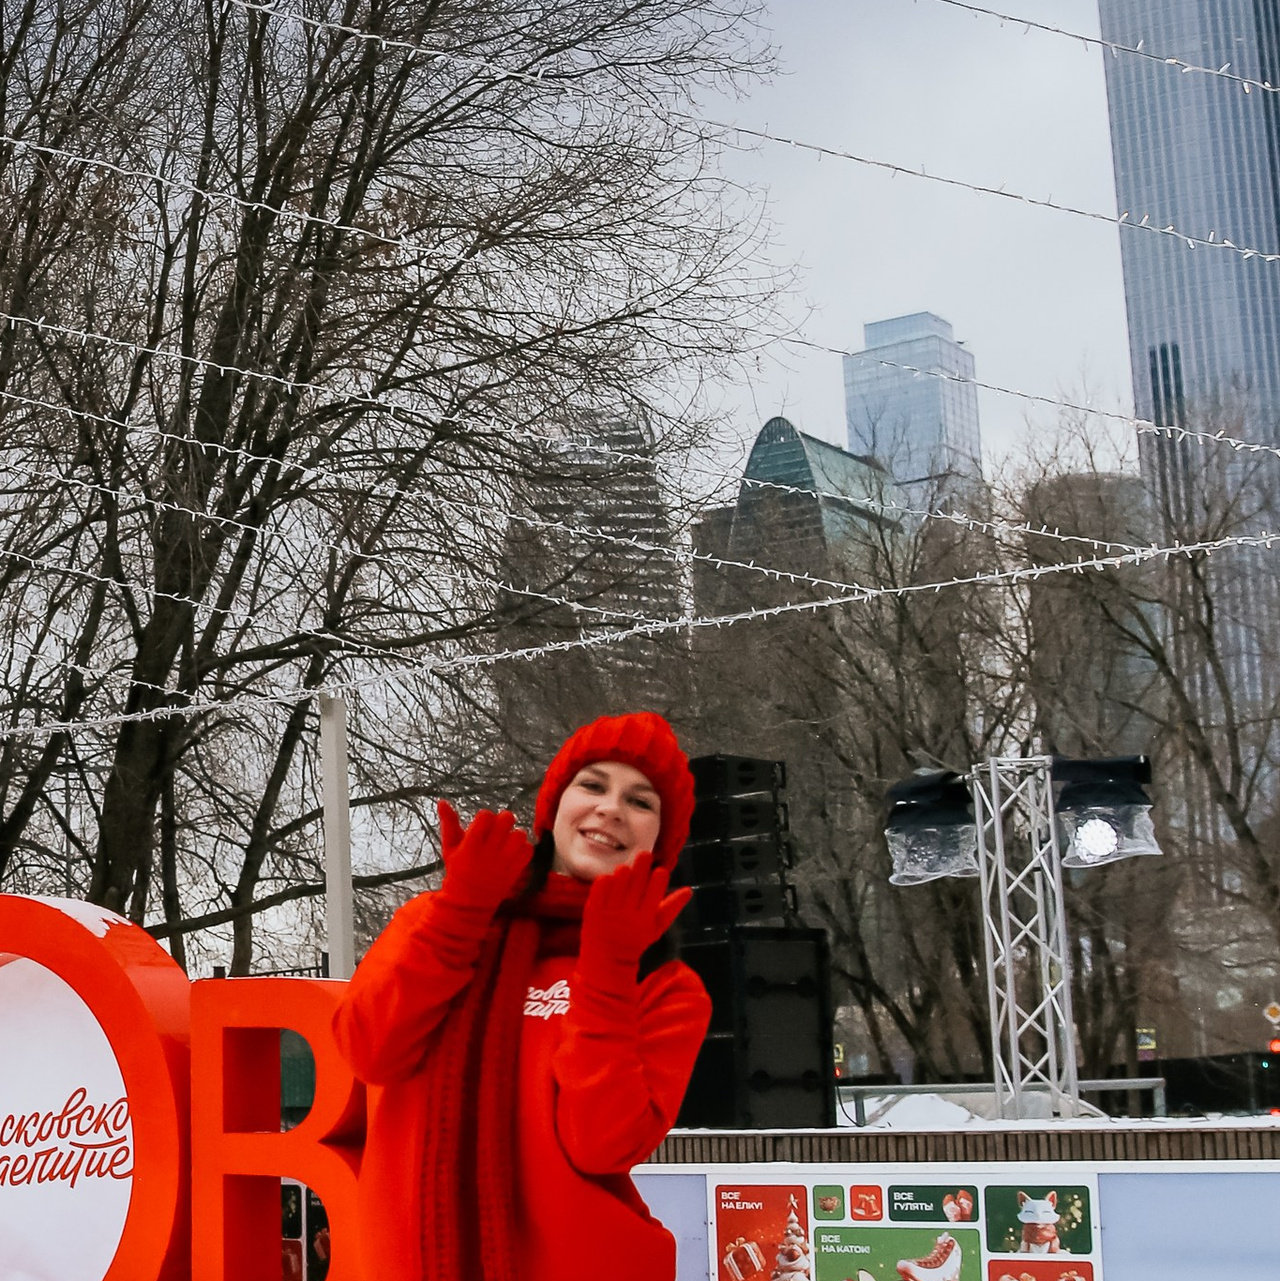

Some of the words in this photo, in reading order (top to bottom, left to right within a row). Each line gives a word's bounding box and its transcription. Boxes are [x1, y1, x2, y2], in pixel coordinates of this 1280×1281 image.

[721, 1192, 741, 1200] ВСЕ
[893, 1192, 914, 1201] ВСЕ
[721, 1201, 735, 1210] НА
[820, 1234, 841, 1243] ВСЕ
[821, 1244, 836, 1253] НА
